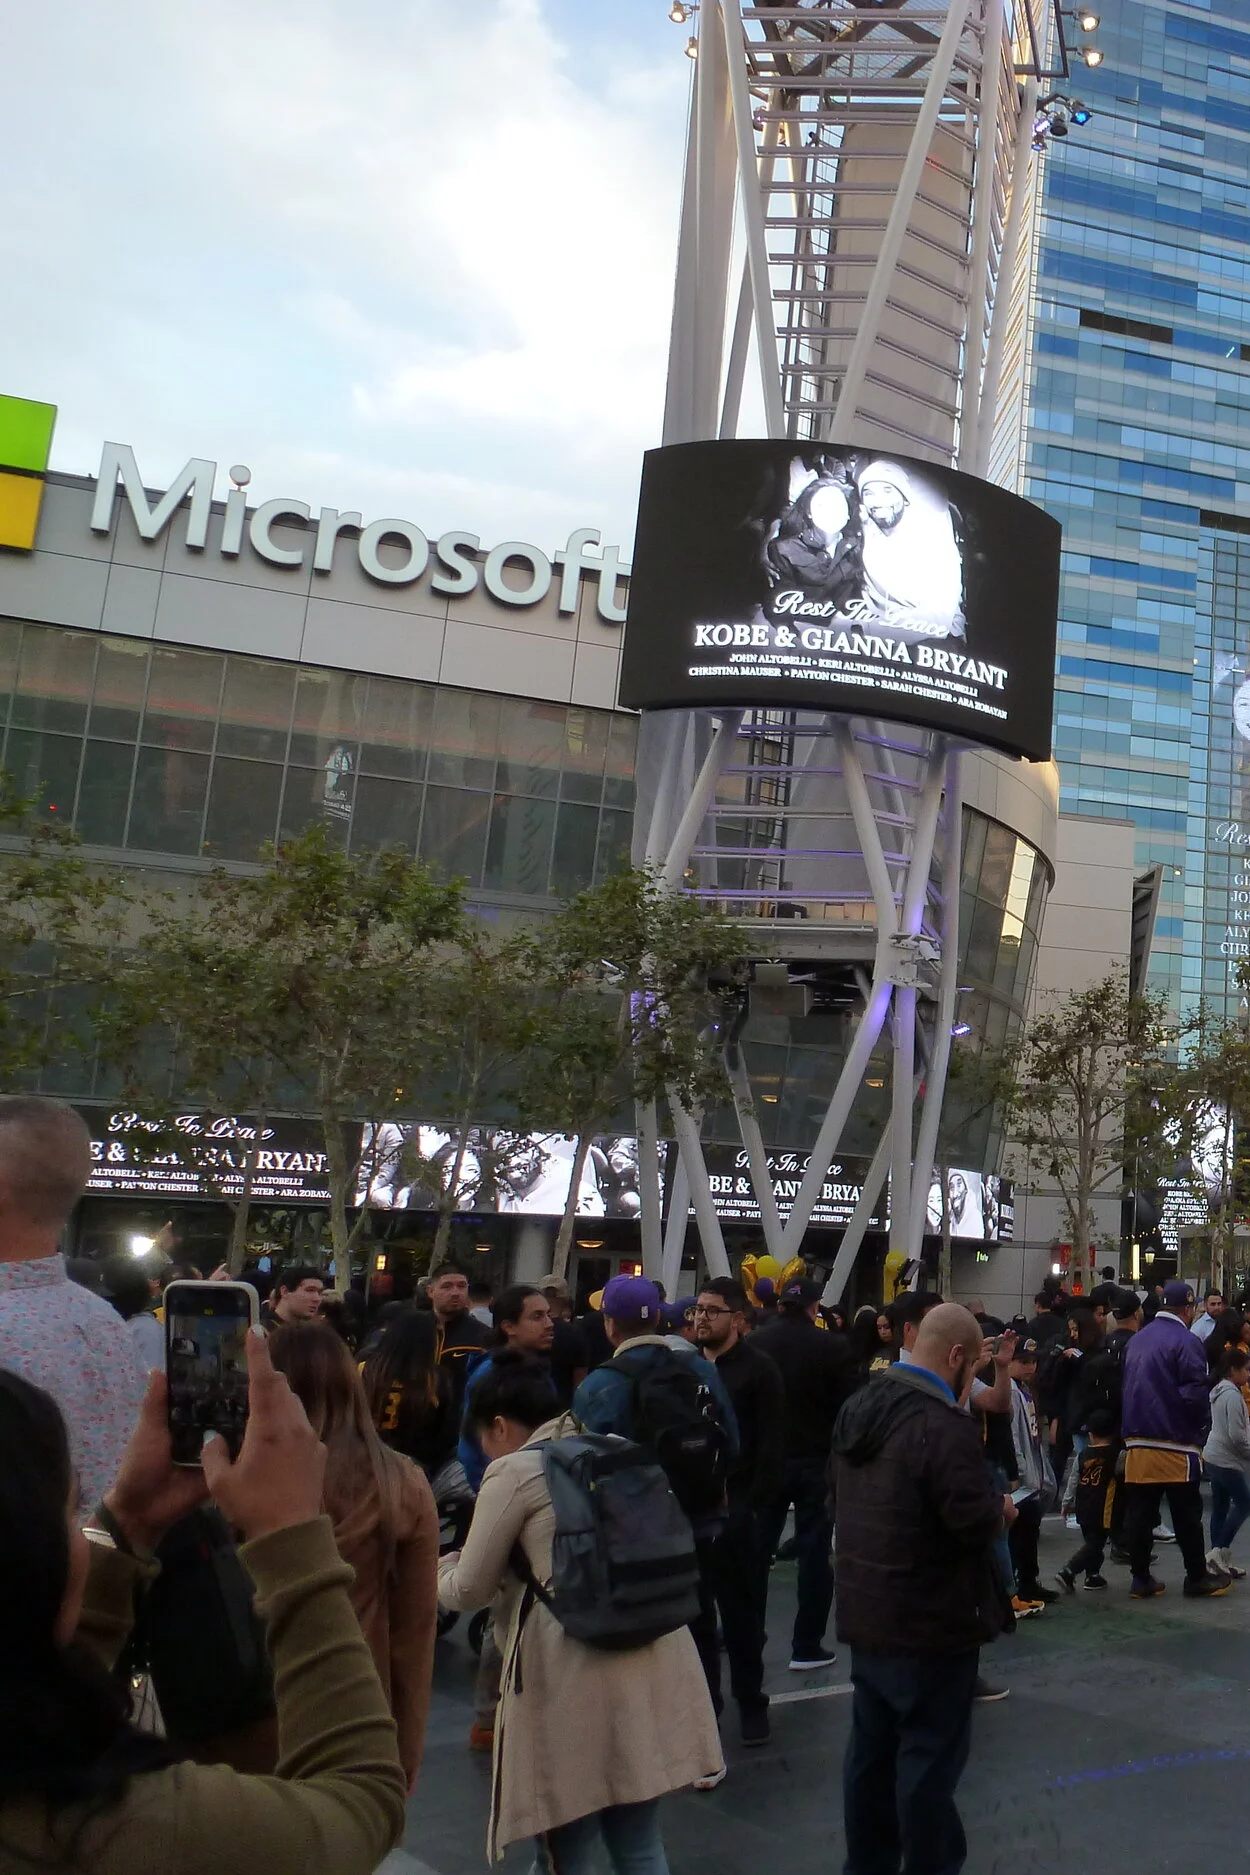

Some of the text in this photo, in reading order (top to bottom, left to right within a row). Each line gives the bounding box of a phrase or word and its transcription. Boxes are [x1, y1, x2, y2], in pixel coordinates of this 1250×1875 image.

[90, 440, 632, 624] Microsoft
[773, 590, 950, 637] Rest In Peace
[694, 624, 1008, 690] KOBE & GIANNA BRYANT
[729, 653, 758, 663] JOHN
[818, 658, 842, 671] KERI
[843, 661, 896, 678] ALTOBELLI
[901, 671, 934, 686] ALYSSA
[933, 678, 978, 698] ALTOBELLI
[688, 666, 740, 677] CHRISTINA
[740, 666, 782, 678] MAUSER
[791, 669, 830, 682] PAYTON
[830, 673, 875, 688] CHESTER
[880, 679, 913, 694] SARAH
[913, 685, 953, 703] CHESTER
[957, 697, 974, 709] ARA
[107, 1142, 126, 1161] &
[775, 1154, 800, 1172] In
[735, 1177, 751, 1194] &
